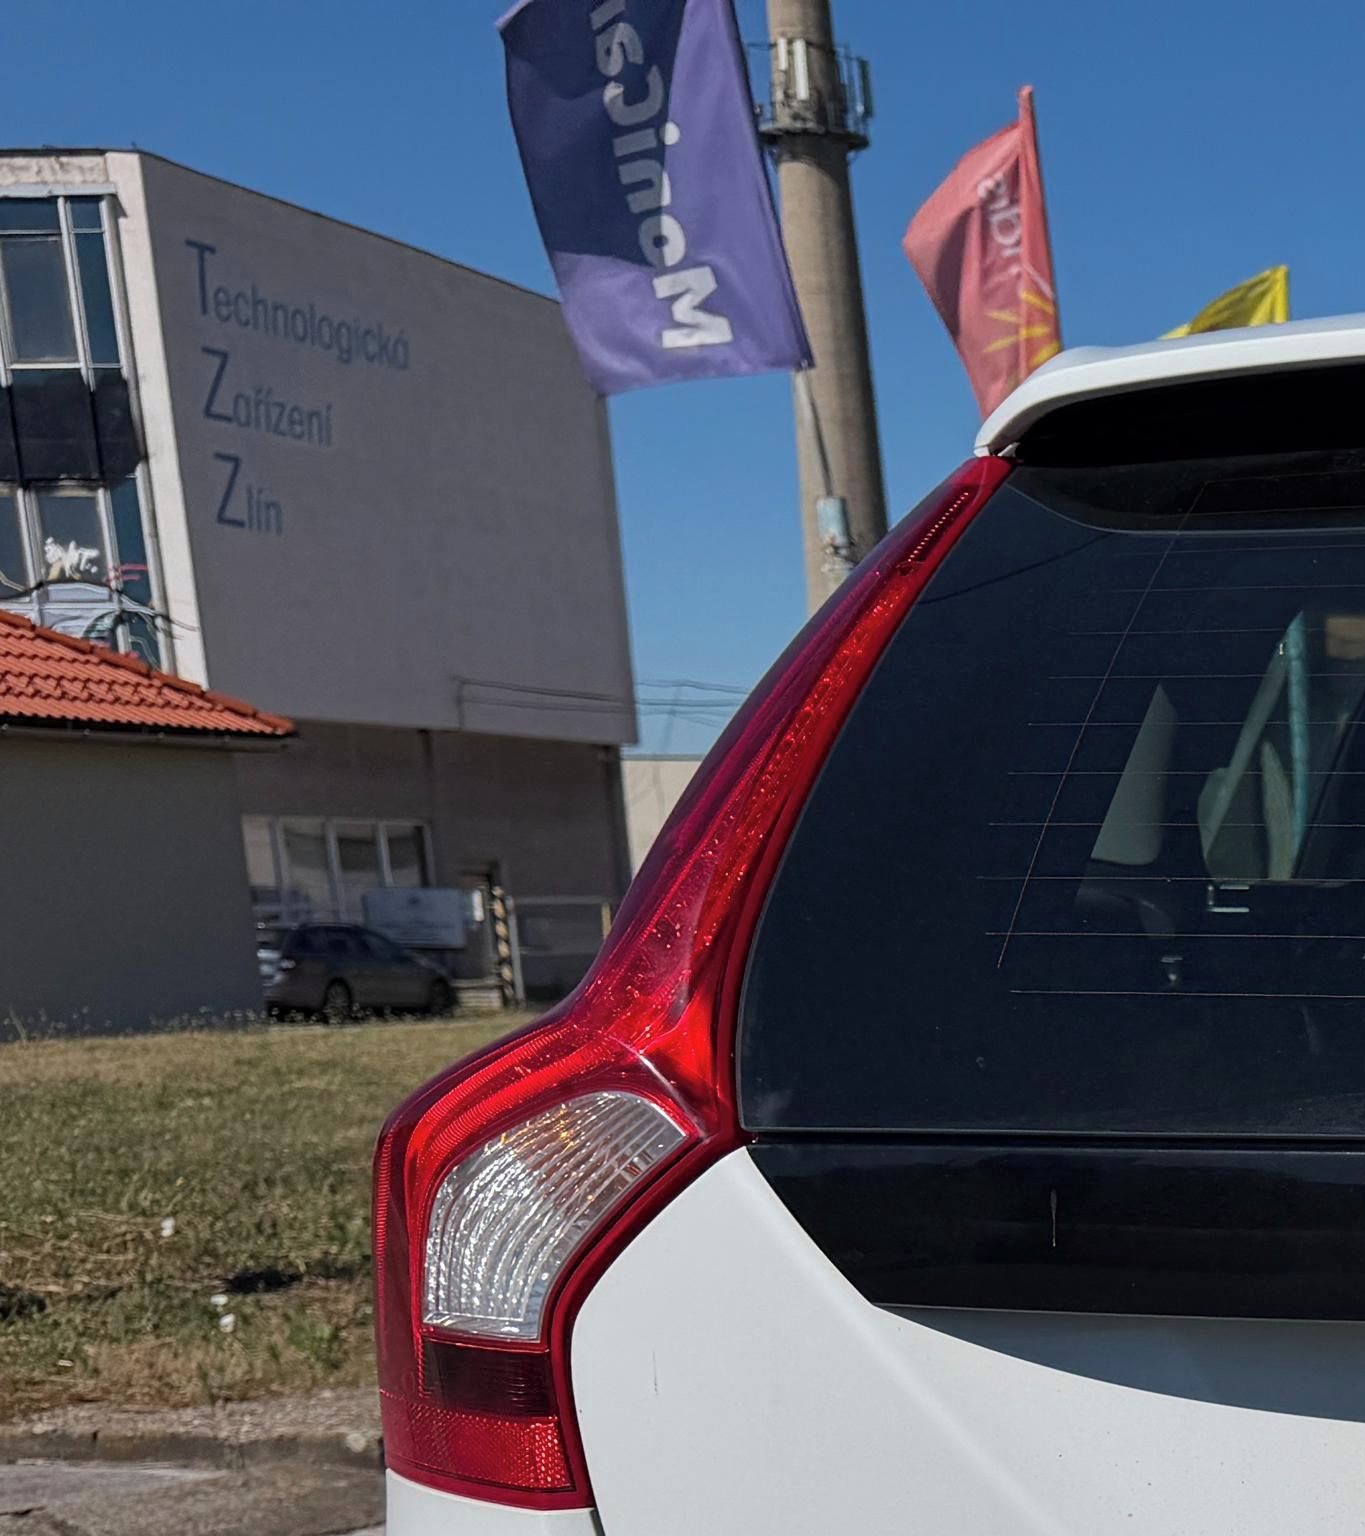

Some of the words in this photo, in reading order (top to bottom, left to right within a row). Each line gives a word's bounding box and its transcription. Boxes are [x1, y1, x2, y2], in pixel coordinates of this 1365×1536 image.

[184, 238, 410, 370] Technologická
[201, 346, 334, 447] Zařízení
[213, 452, 283, 536] Zlín
